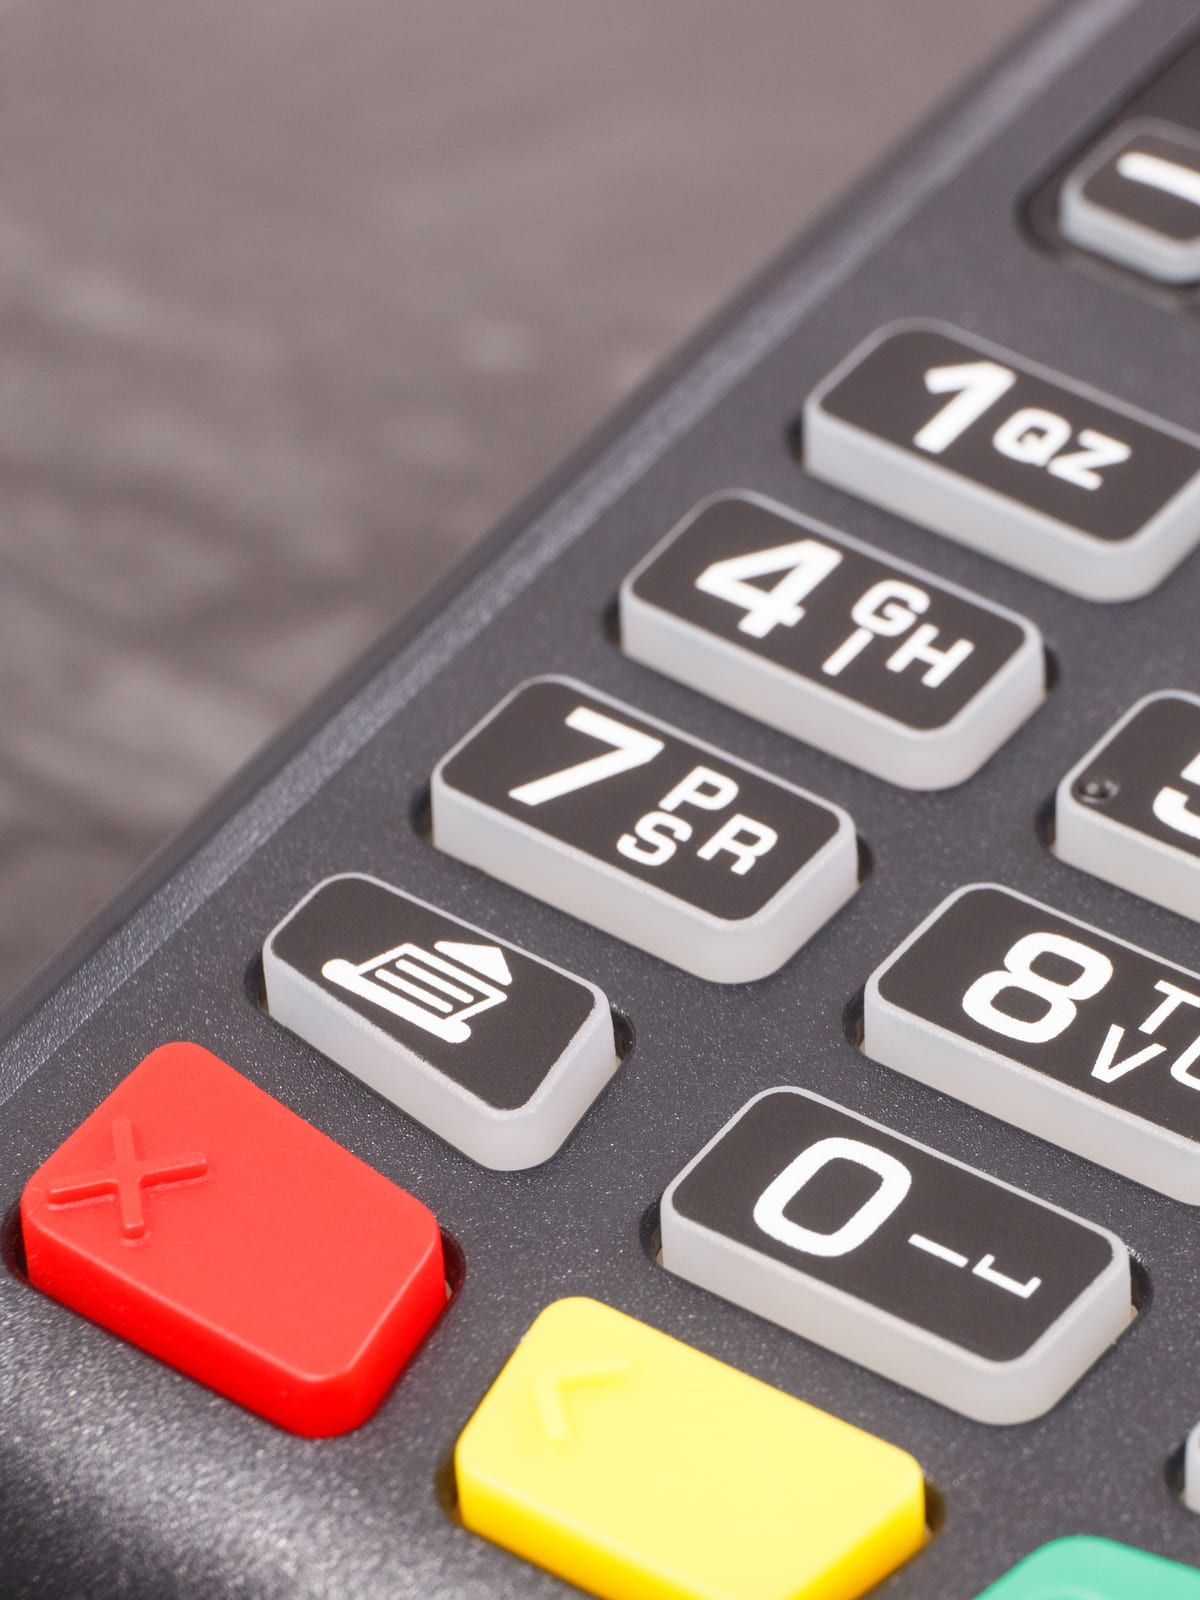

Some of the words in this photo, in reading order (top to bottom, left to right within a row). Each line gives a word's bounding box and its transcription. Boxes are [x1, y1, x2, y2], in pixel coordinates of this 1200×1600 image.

[915, 363, 1014, 452] 1
[994, 409, 1130, 489] QZ
[696, 541, 842, 637] 4
[509, 708, 664, 805] 7
[962, 933, 1113, 1043] 8
[753, 1138, 911, 1257] 0
